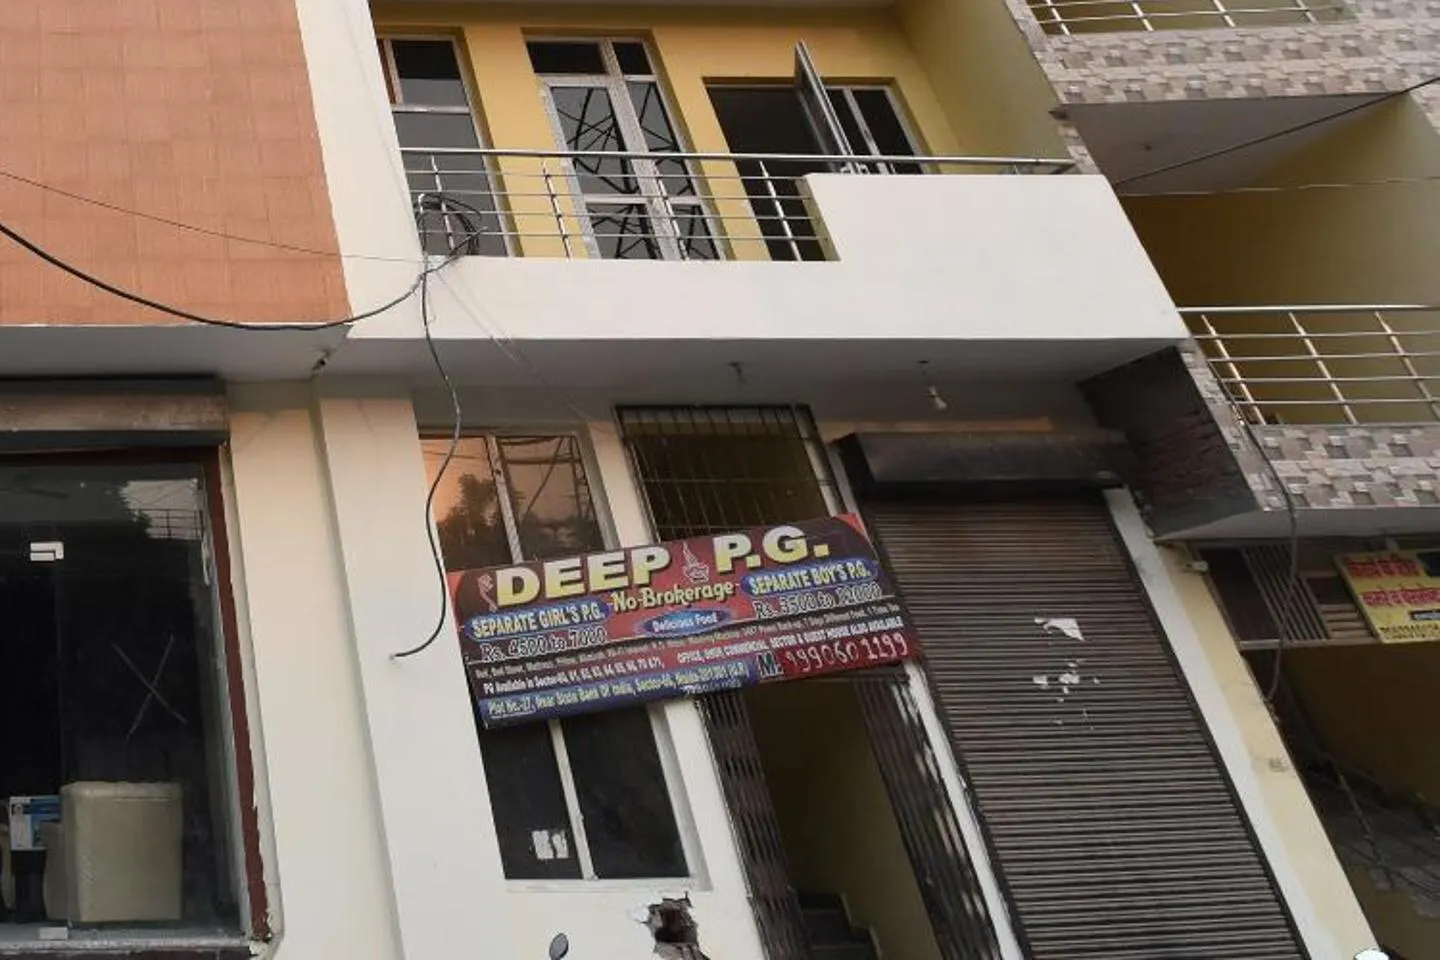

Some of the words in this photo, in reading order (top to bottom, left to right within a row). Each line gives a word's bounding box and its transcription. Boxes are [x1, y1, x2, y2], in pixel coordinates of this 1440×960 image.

[496, 546, 671, 606] DEEP
[713, 525, 830, 573] P.G.
[749, 569, 809, 596] SEPARATE
[813, 563, 845, 585] BOY'S
[847, 559, 869, 579] P.G.
[611, 581, 735, 614] No-Brokerage
[753, 596, 777, 620] Rs.
[473, 610, 535, 639] SEPARATE
[539, 603, 578, 629] GIRL'S
[581, 600, 603, 622] P.G.
[694, 610, 717, 626] Food
[481, 640, 503, 663] Rs.
